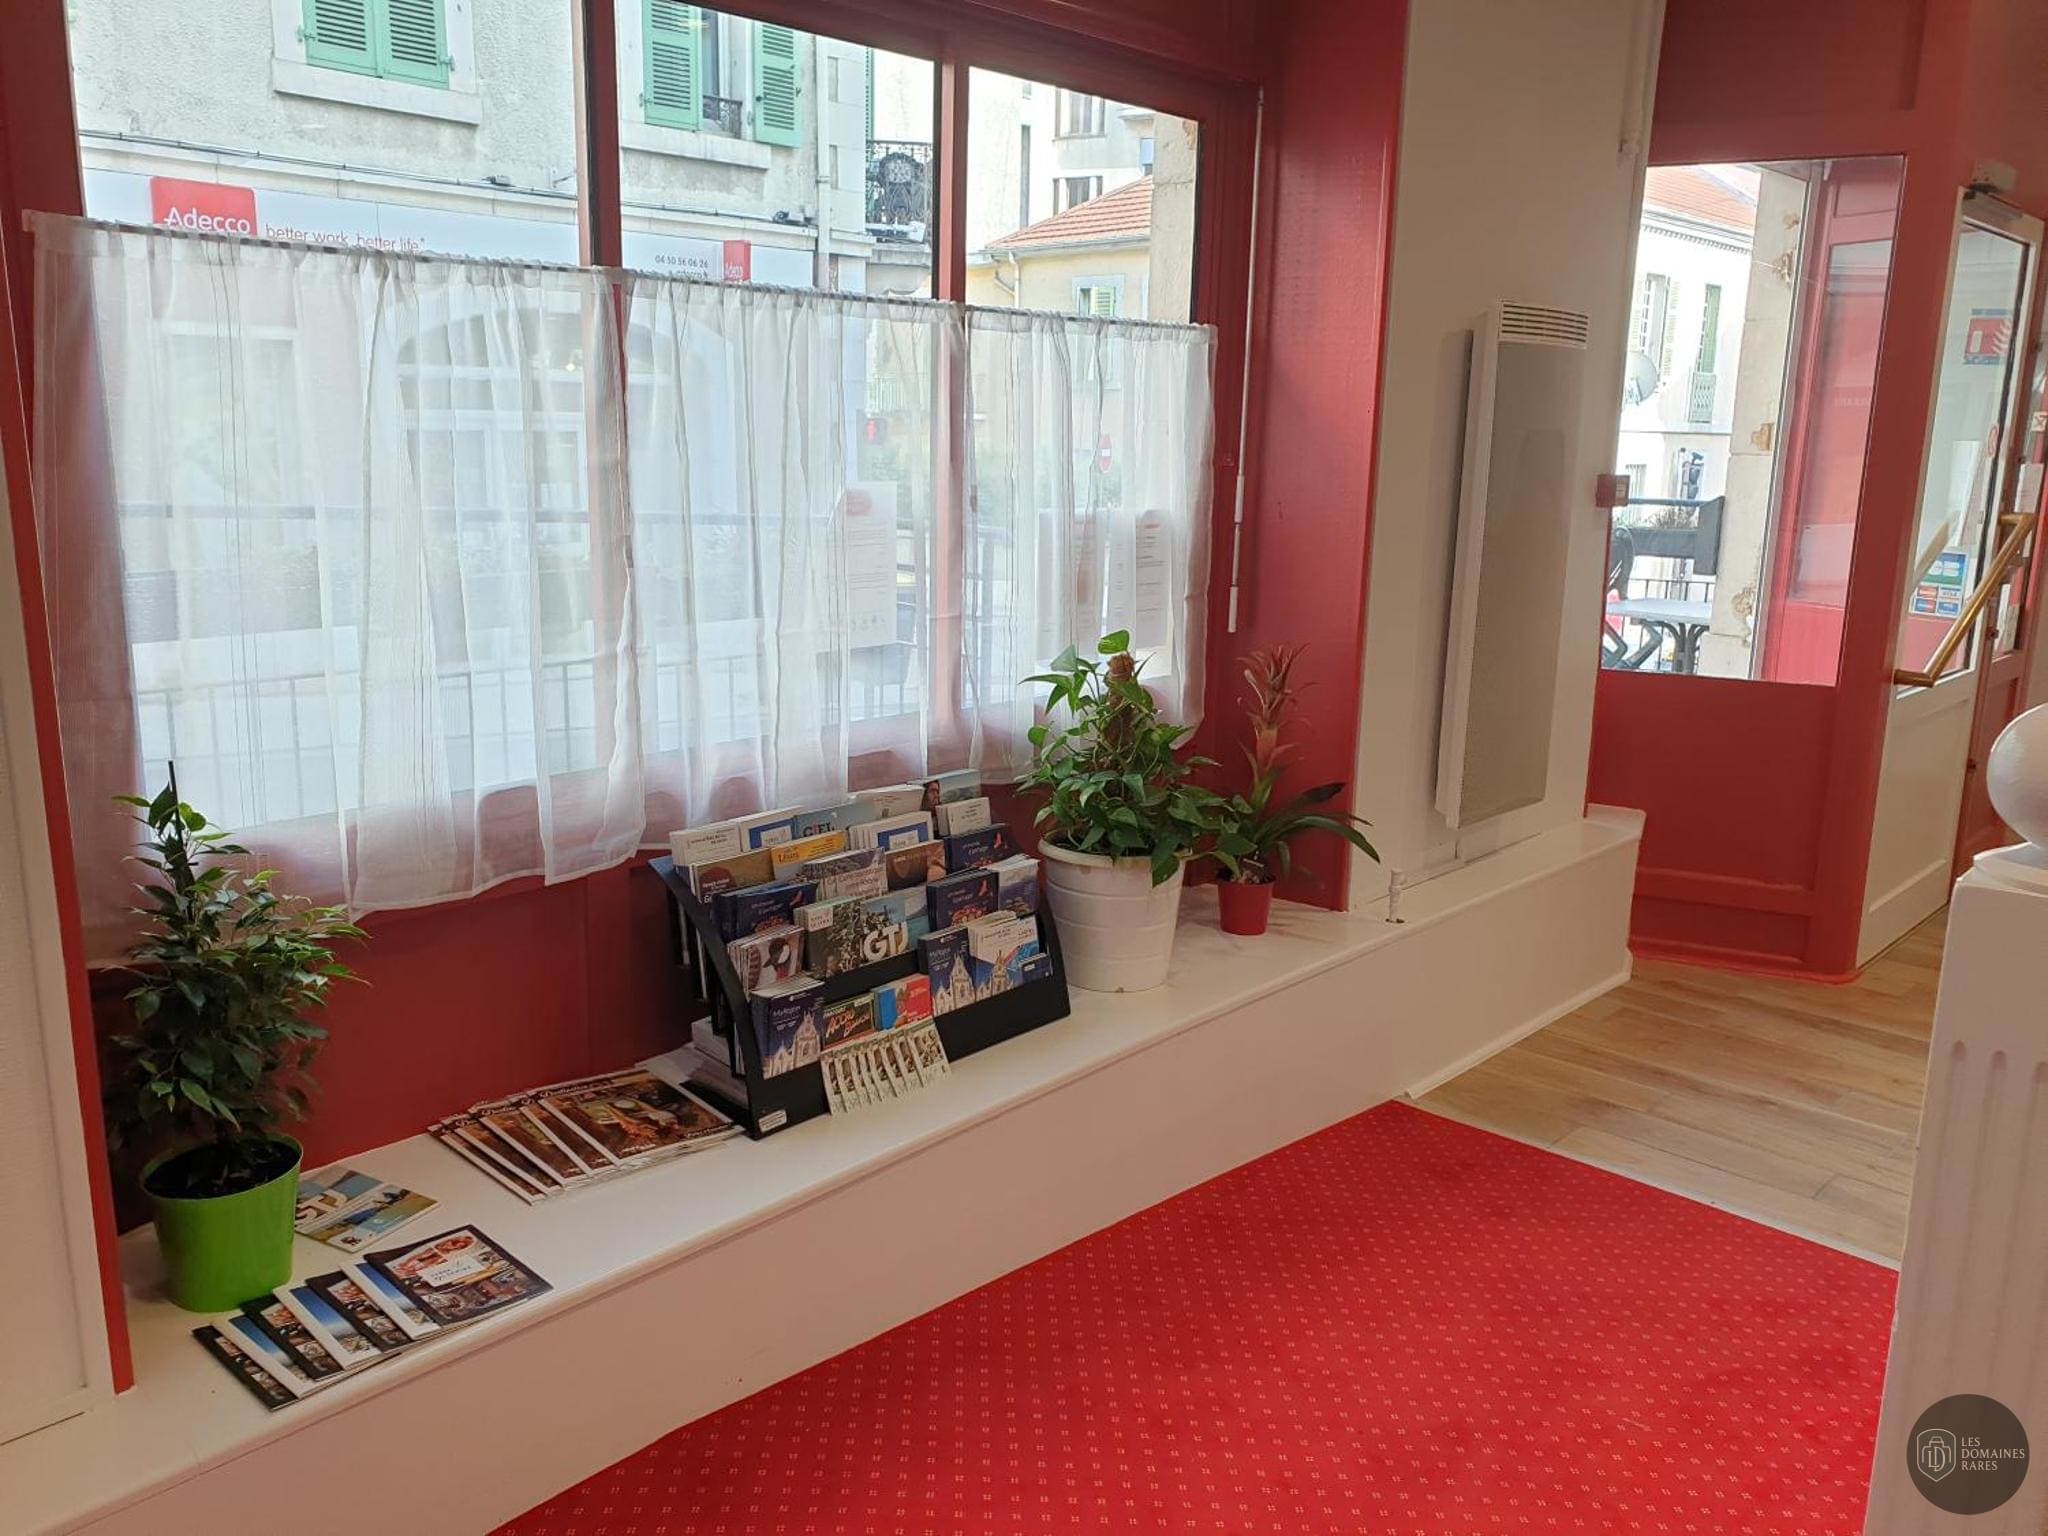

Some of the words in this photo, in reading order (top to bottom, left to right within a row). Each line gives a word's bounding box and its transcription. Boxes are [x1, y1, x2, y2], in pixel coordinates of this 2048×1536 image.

[163, 207, 250, 233] Adecco
[265, 223, 308, 241] better
[863, 921, 908, 961] GTJ
